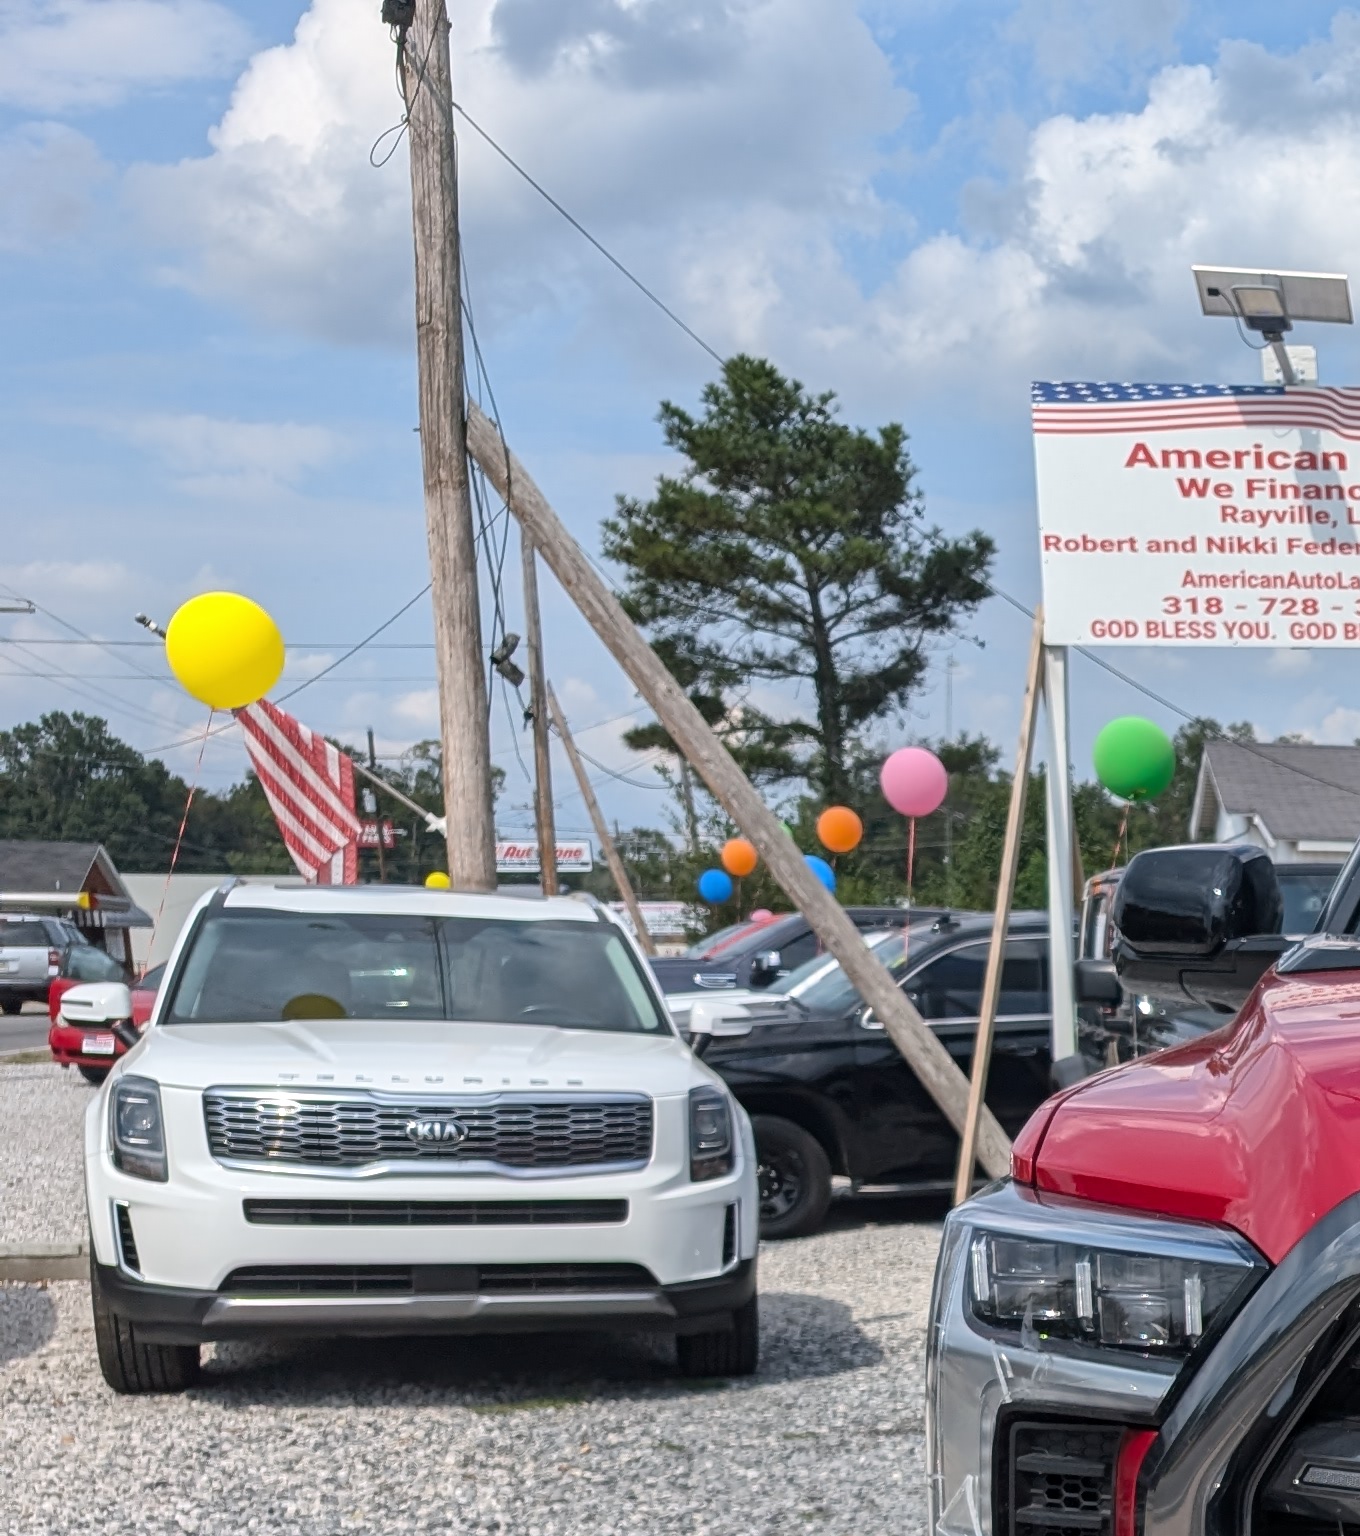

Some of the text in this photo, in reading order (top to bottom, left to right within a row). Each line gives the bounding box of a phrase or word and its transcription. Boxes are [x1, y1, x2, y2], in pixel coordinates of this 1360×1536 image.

[1124, 442, 1348, 471] American
[1175, 477, 1234, 499] We
[1219, 504, 1338, 528] Rayville,
[1042, 534, 1138, 553] Robert
[1146, 535, 1198, 554] and
[1205, 536, 1278, 555] Nikki
[1163, 596, 1224, 615] 318
[1257, 597, 1319, 616] 728
[1090, 619, 1139, 639] GOD
[1145, 620, 1217, 639] BLESS
[1222, 621, 1278, 640] YOU.
[1289, 621, 1337, 640] GOD
[416, 1121, 460, 1141] KIA
